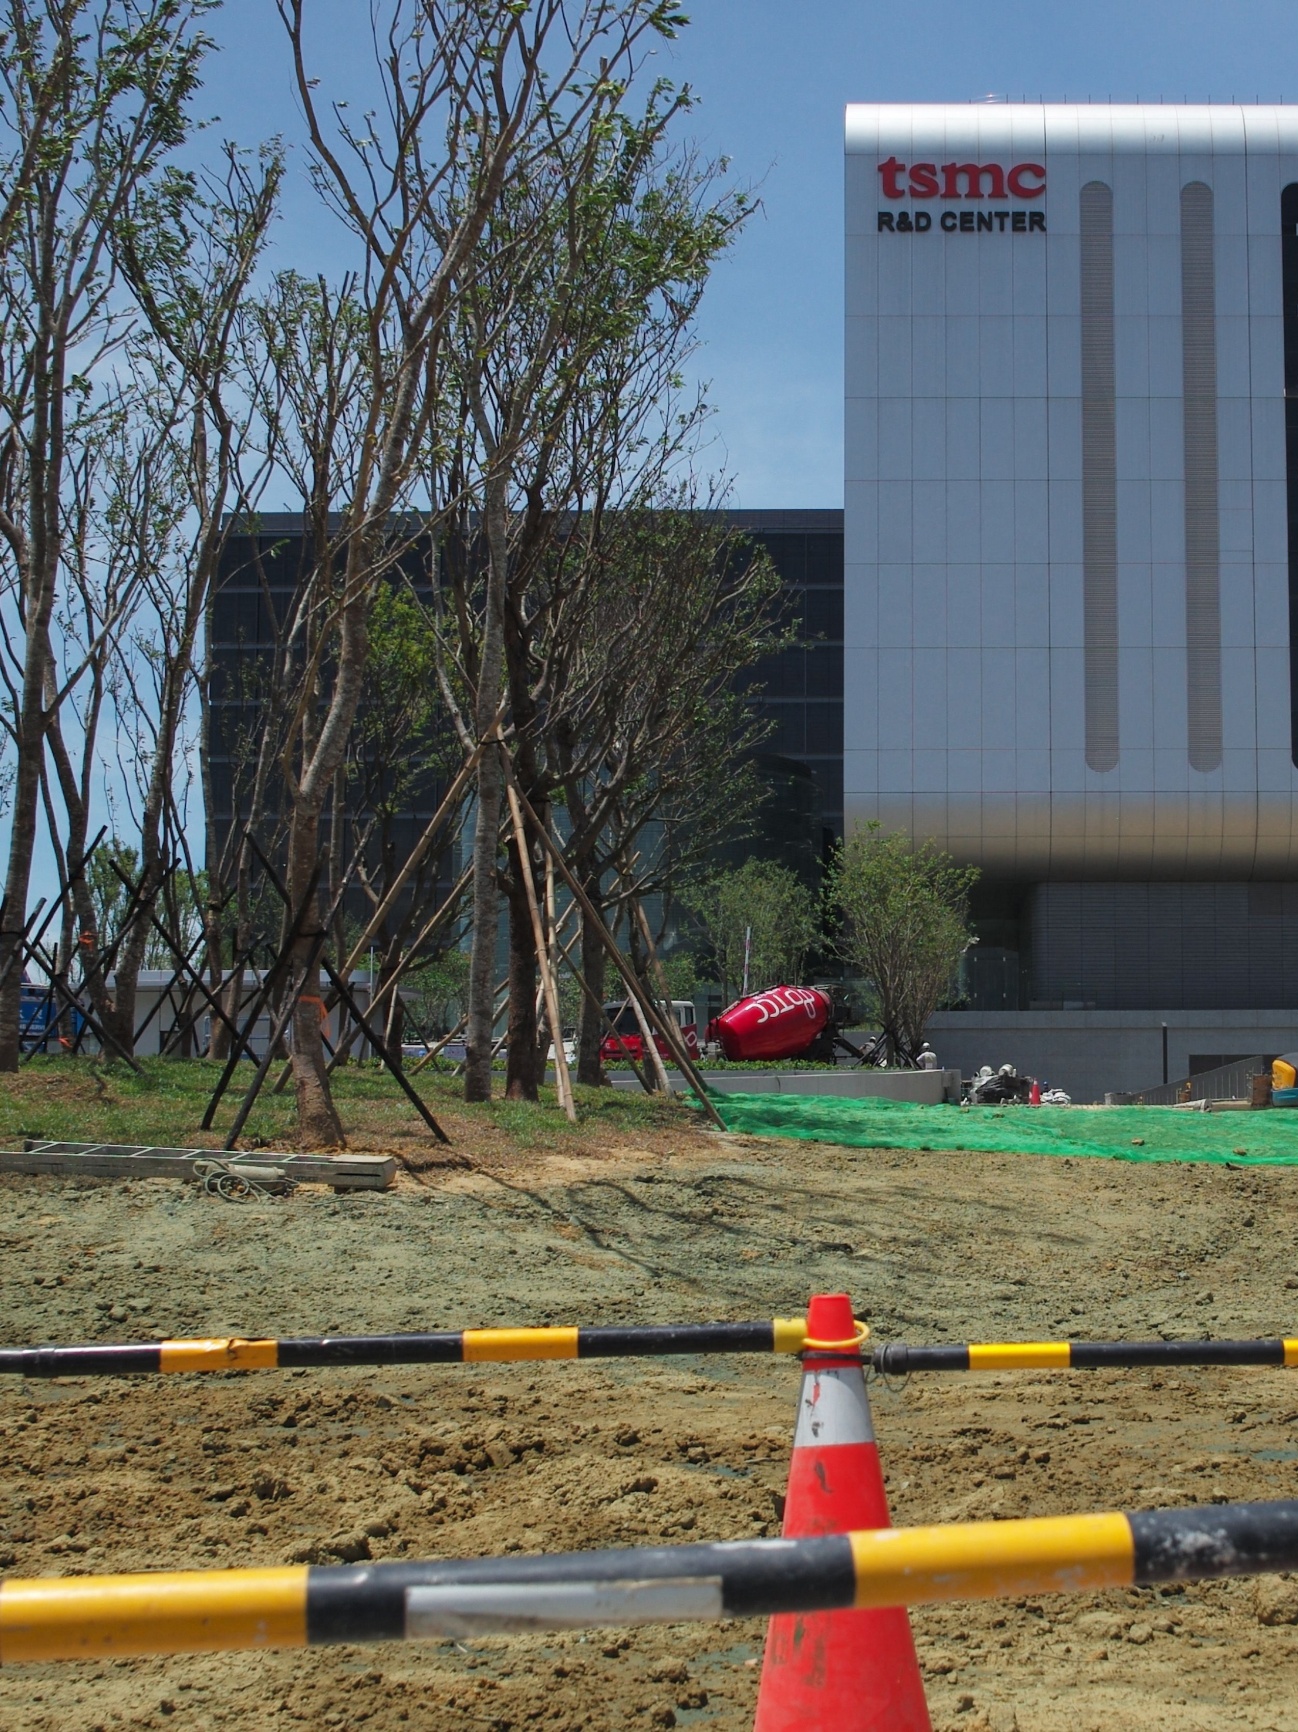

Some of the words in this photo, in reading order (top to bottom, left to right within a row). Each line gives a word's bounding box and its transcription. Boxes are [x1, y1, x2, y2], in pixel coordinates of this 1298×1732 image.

[877, 156, 1046, 199] tsmc
[877, 211, 932, 232] R&D
[940, 211, 1047, 232] CENTER
